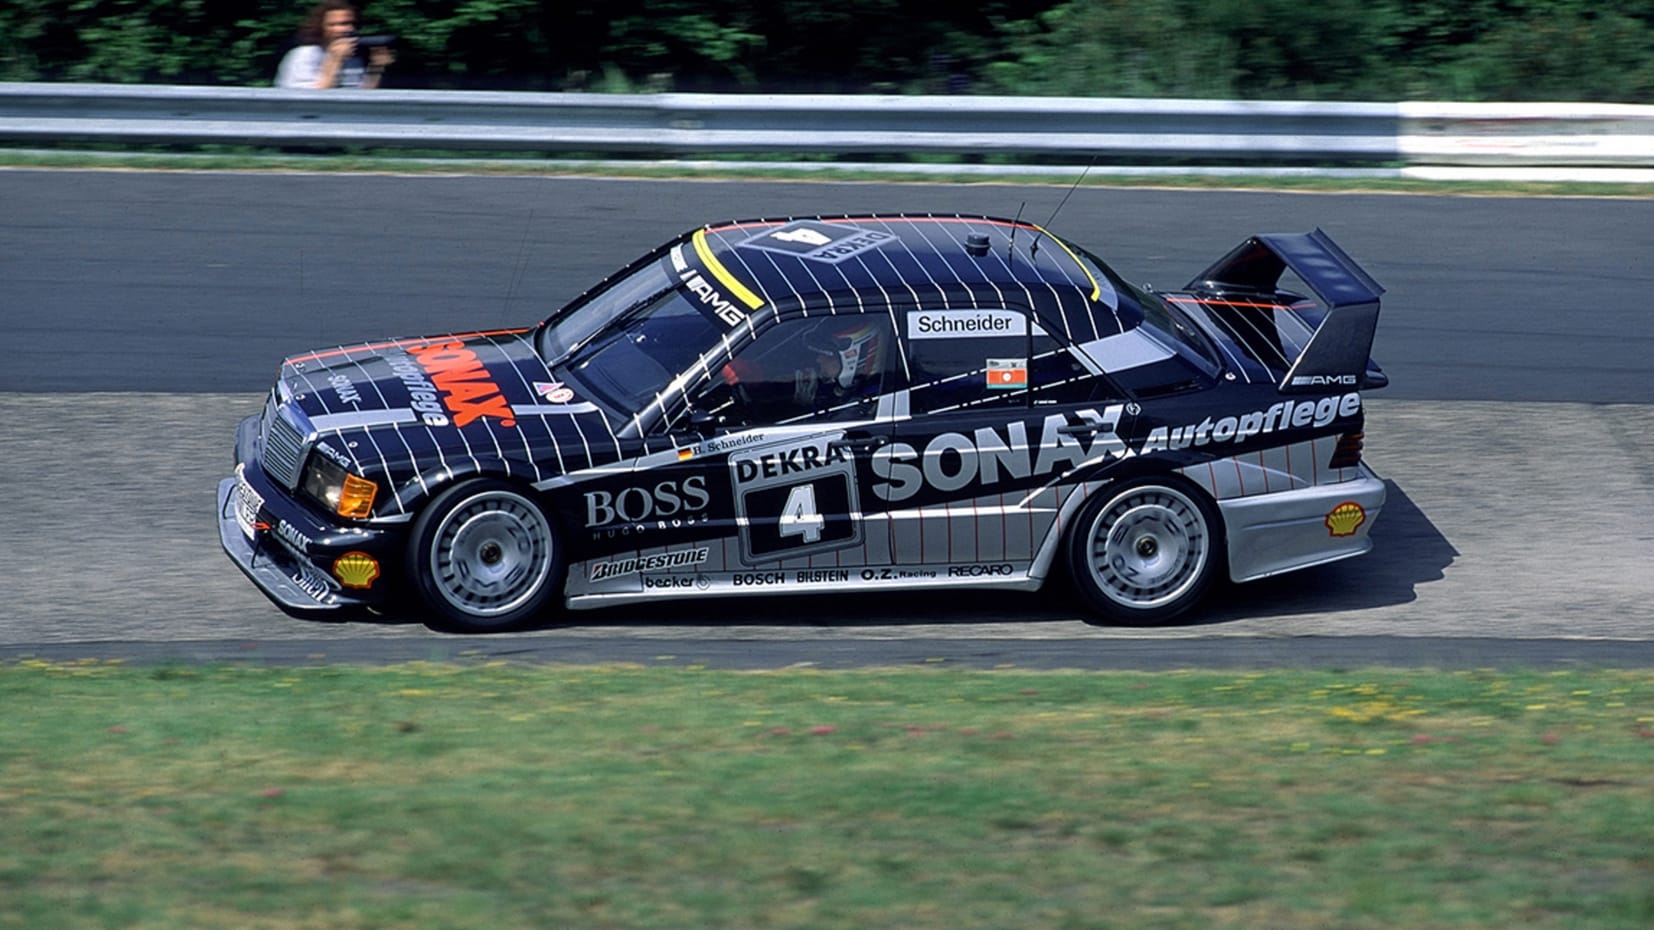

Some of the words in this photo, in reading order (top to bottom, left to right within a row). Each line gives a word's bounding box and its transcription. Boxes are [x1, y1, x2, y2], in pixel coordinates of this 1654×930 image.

[770, 228, 832, 246] 4
[813, 232, 890, 259] DEKRA
[695, 280, 746, 327] AMG
[918, 314, 1012, 333] Schneider
[328, 374, 362, 404] SONAX
[405, 341, 514, 428] SONAX
[1311, 375, 1356, 385] AMG
[1140, 393, 1360, 455] Autopflege
[708, 433, 764, 453] Schneider
[871, 404, 1131, 501] SONAX
[736, 442, 848, 484] DEKRA
[583, 475, 710, 528] BOSS
[779, 483, 825, 543] 4
[277, 519, 312, 553] SONAX
[592, 523, 645, 541] HUGO
[645, 575, 694, 588] becker
[733, 572, 785, 586] BOSCH
[797, 570, 849, 583] BILSTEIN
[948, 563, 1013, 577] RECARO
